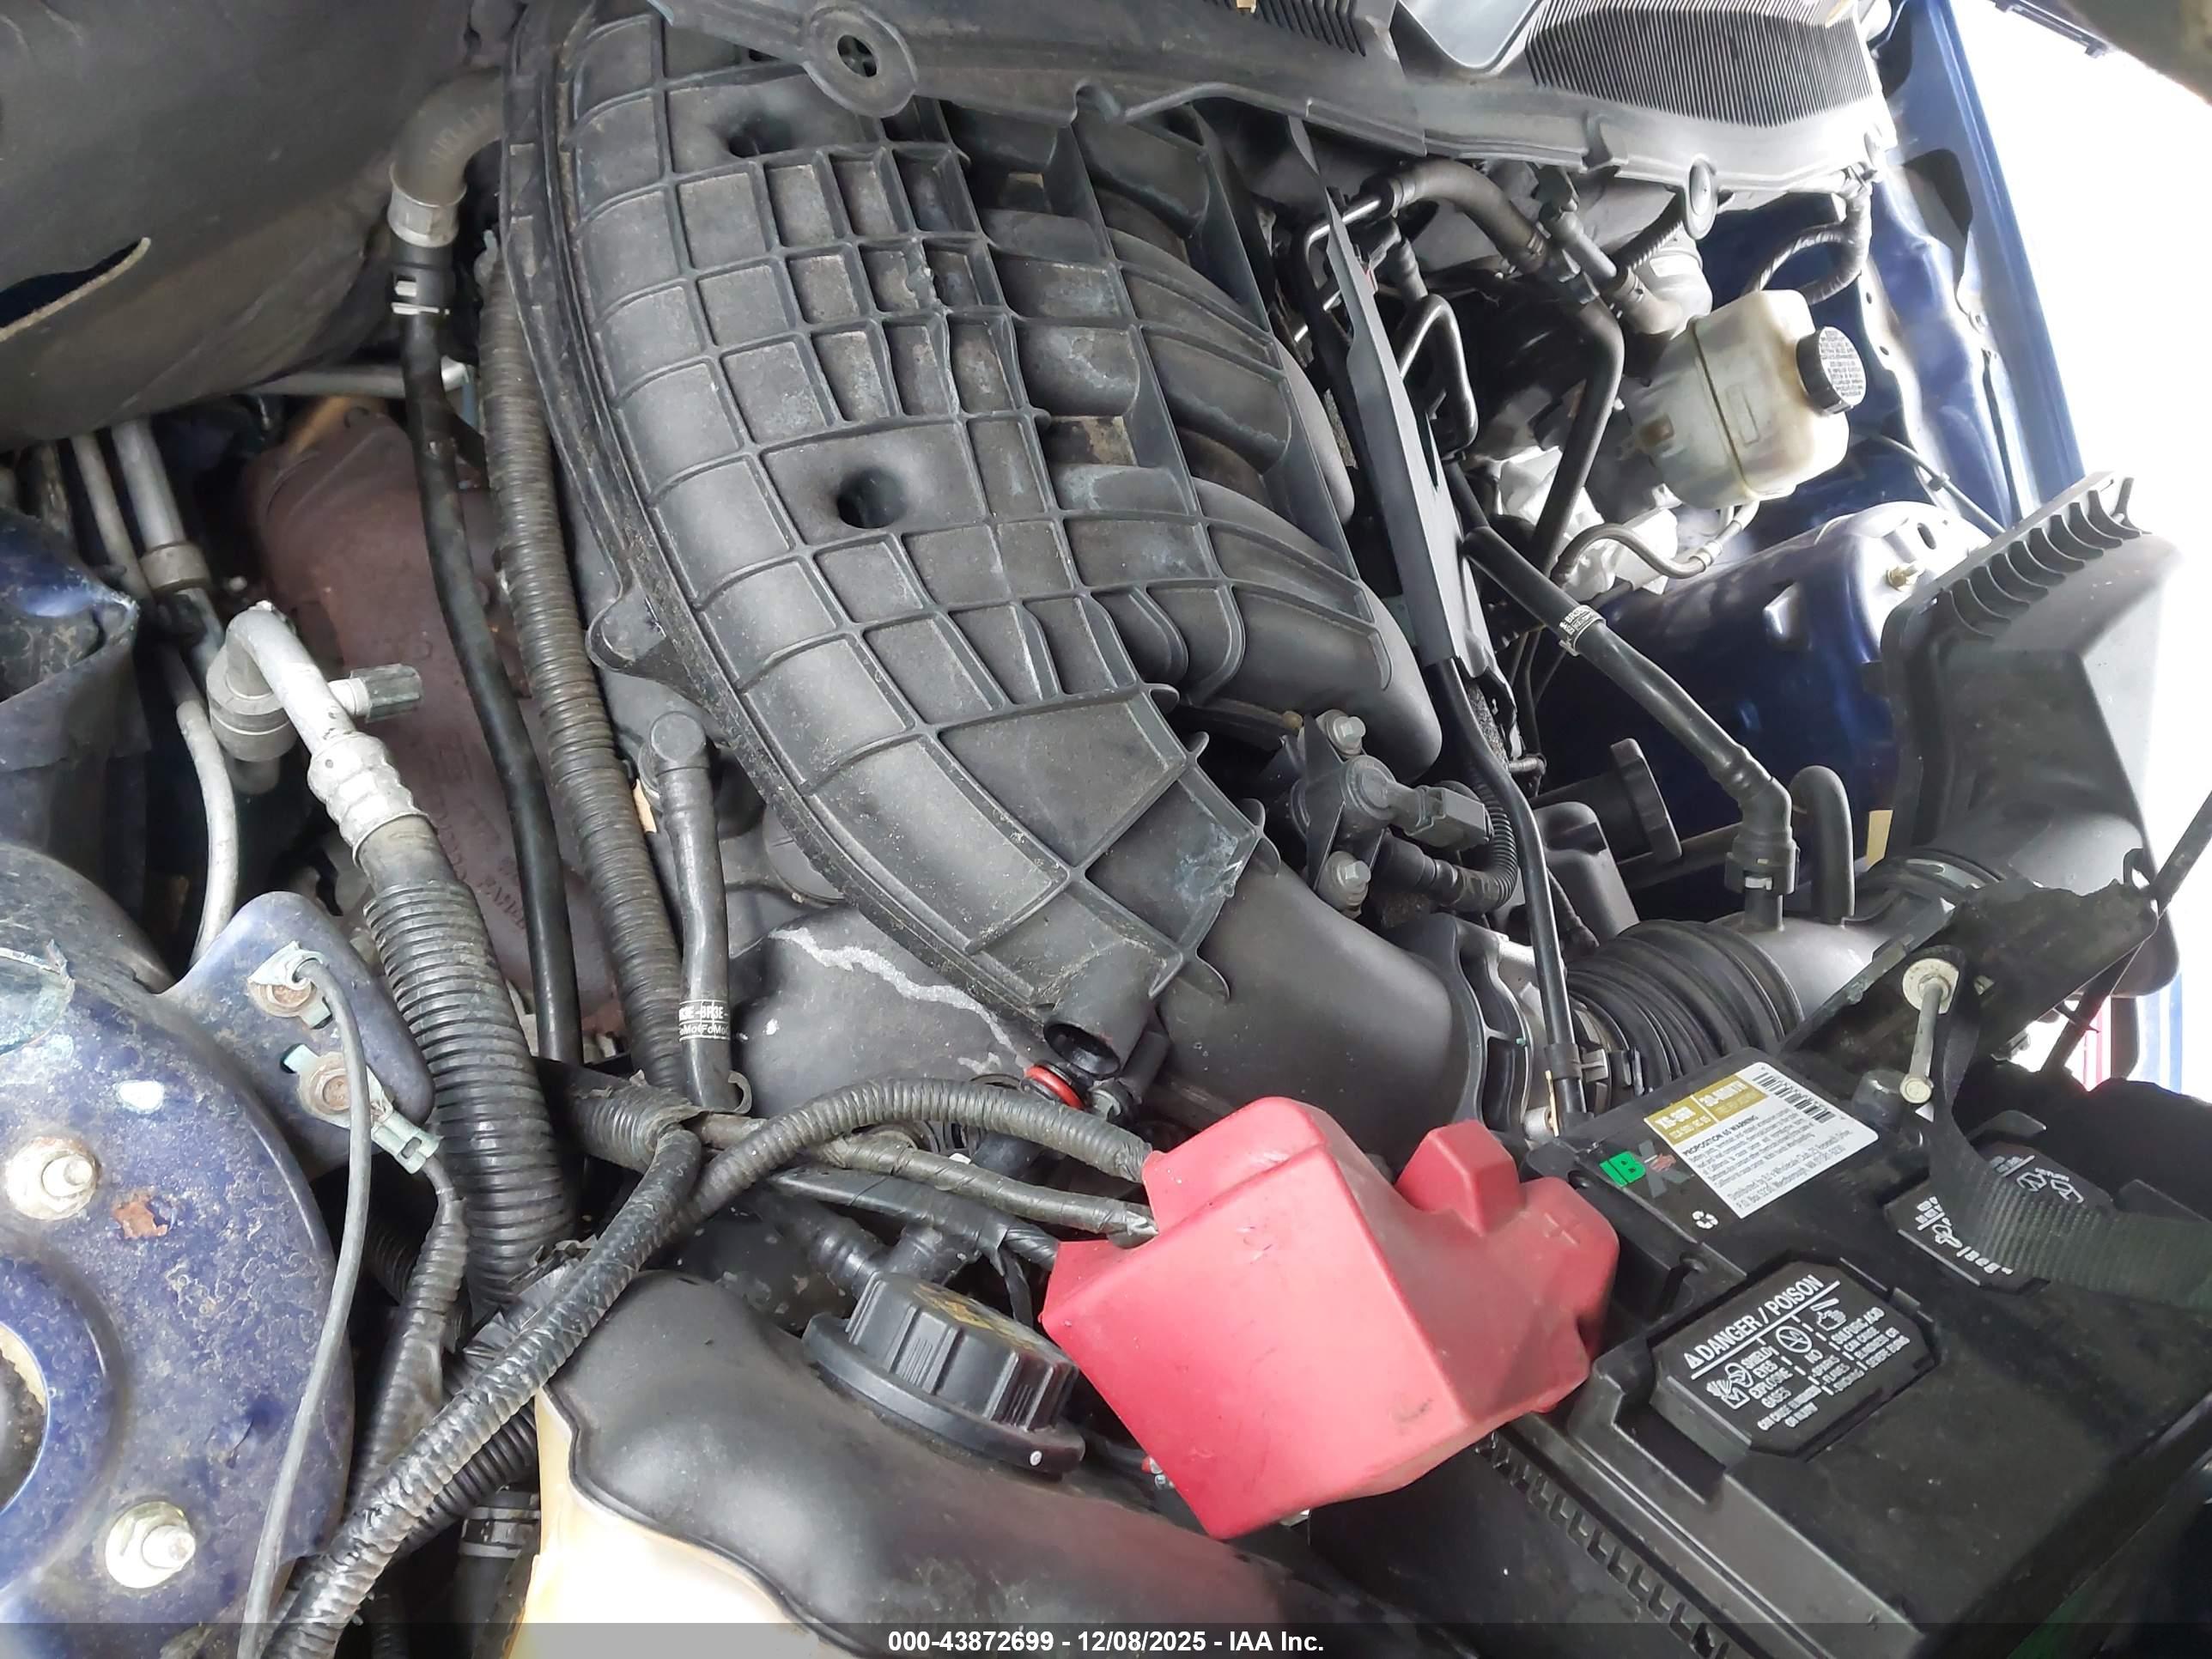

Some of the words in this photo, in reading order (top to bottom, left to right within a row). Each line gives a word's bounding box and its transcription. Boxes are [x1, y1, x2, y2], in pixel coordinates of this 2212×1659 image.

[1694, 1316, 1764, 1361] DANGER
[1765, 1274, 1825, 1316] POISON
[1741, 1347, 1773, 1370] SHIELD
[1804, 1349, 1824, 1364] NO
[1753, 1360, 1778, 1379] EYES
[1748, 1367, 1794, 1400] EXPLOSIVE
[1761, 1387, 1792, 1409] GASES
